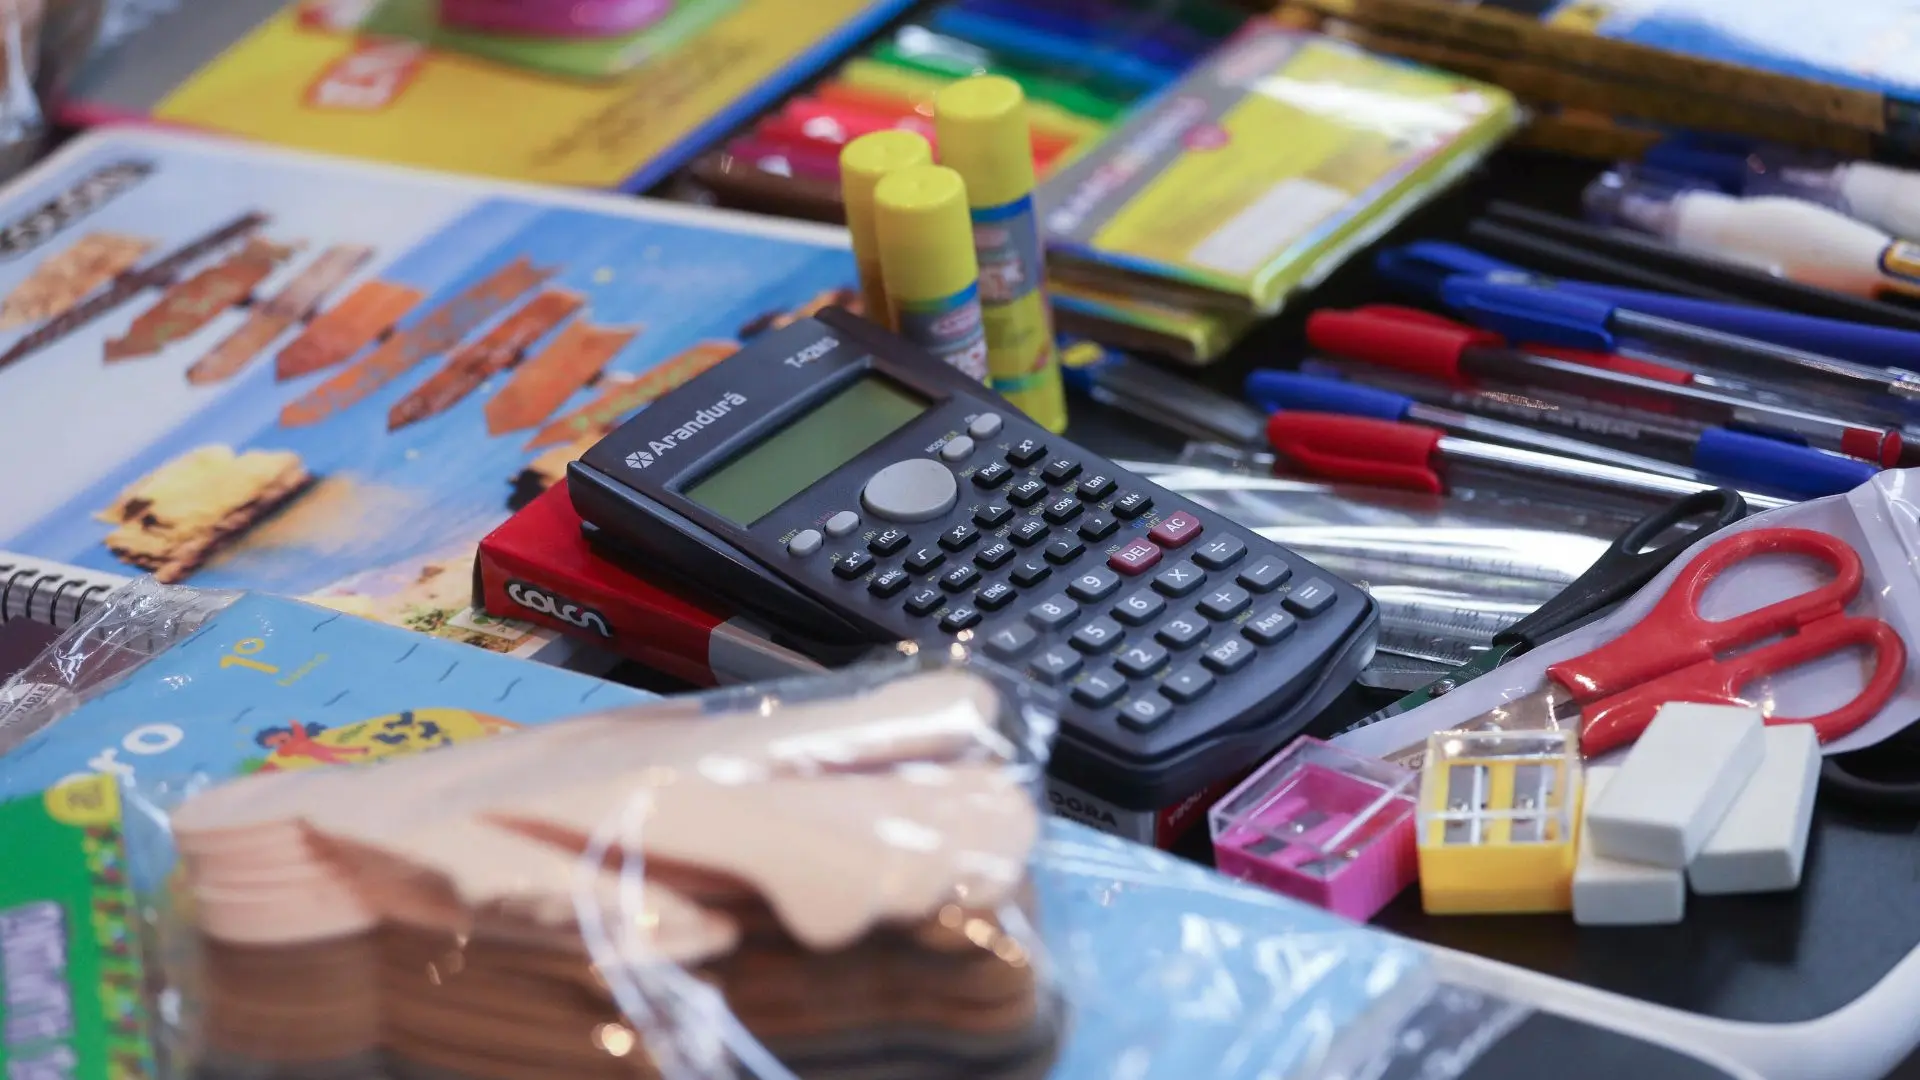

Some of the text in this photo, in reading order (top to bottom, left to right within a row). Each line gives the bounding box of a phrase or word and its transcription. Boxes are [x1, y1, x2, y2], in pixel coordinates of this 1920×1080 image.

[1018, 480, 1039, 492] log
[1085, 475, 1106, 489] tan
[1053, 497, 1073, 511] cos
[1022, 521, 1040, 533] sin
[1165, 518, 1186, 533] AC
[778, 529, 799, 544] SHIFT
[879, 529, 899, 544] nCr
[984, 543, 1005, 557] hyp
[1122, 545, 1152, 562] DEL
[1083, 575, 1101, 588] 9
[984, 584, 1007, 599] ENG
[1042, 602, 1061, 615] 8
[1128, 596, 1148, 610] 6
[948, 606, 972, 622] RCL
[1171, 620, 1193, 634] 3
[1255, 612, 1284, 631] Ans
[999, 631, 1017, 644] 7
[1084, 624, 1105, 639] 5
[1046, 652, 1065, 666] 4
[1129, 648, 1153, 663] 2
[1089, 676, 1110, 690] 1
[1133, 700, 1156, 716] 0
